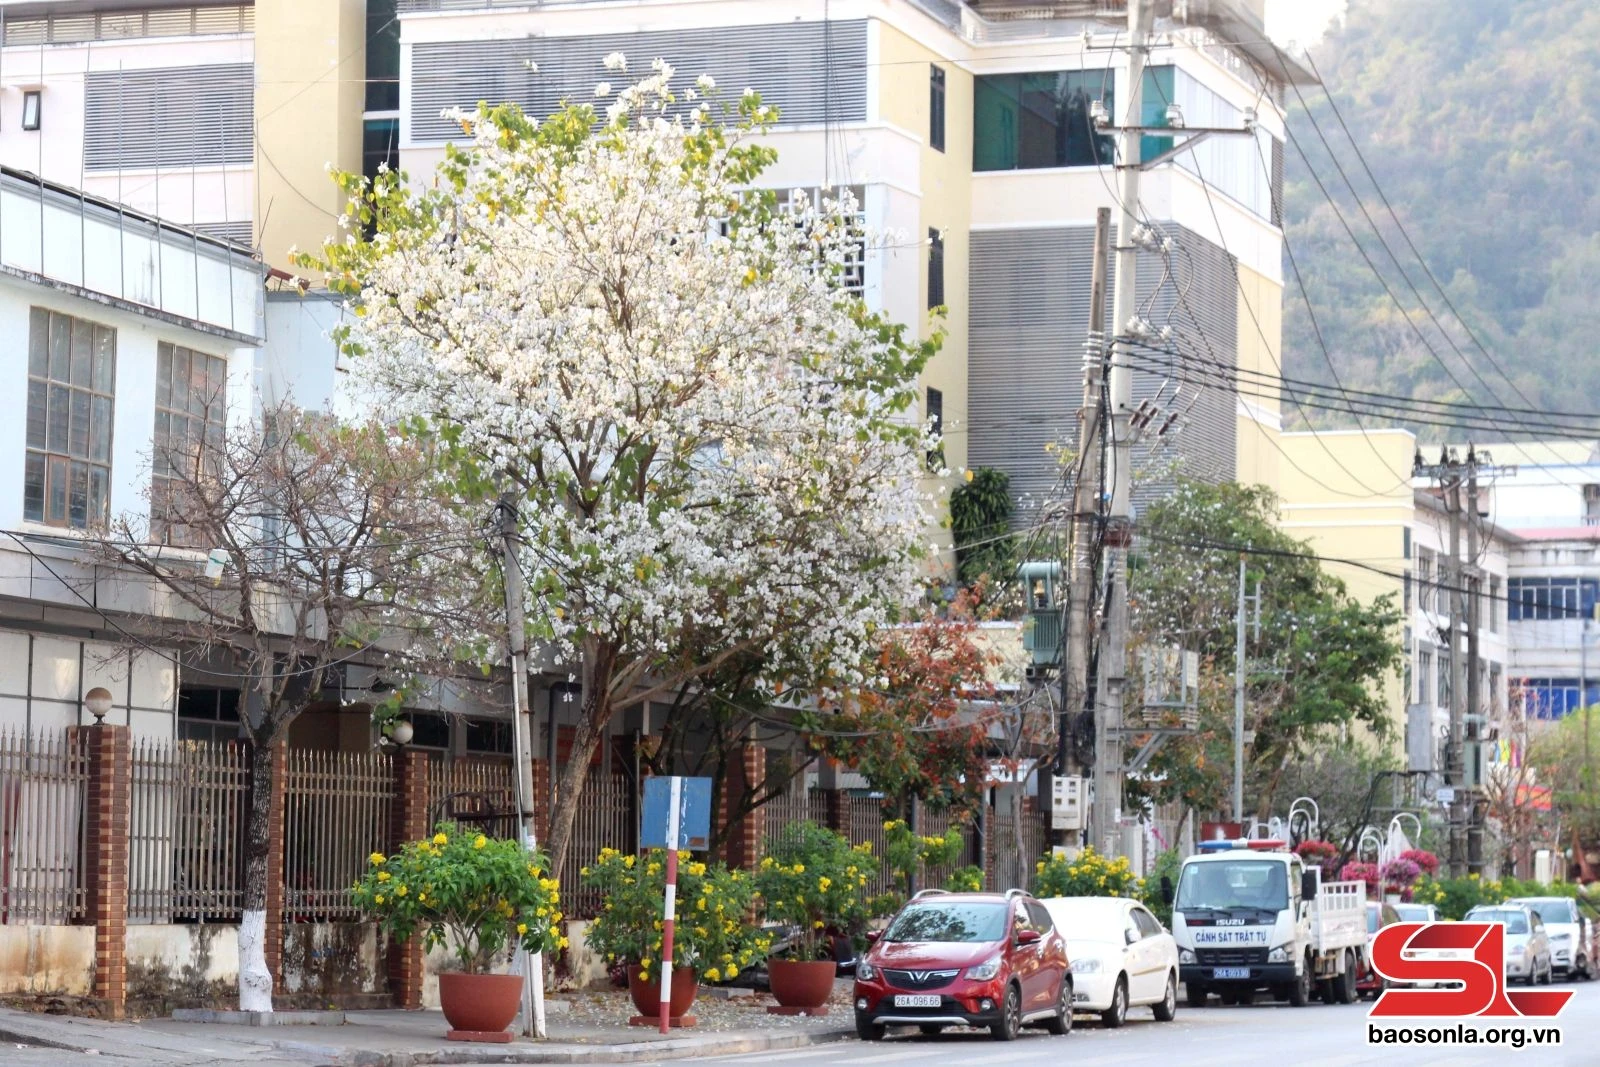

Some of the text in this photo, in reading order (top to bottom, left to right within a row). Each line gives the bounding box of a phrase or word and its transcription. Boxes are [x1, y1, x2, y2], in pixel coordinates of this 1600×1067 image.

[1216, 918, 1245, 926] ISUZU
[1195, 929, 1267, 945] CẢNH SÁT TRẬT TỰ
